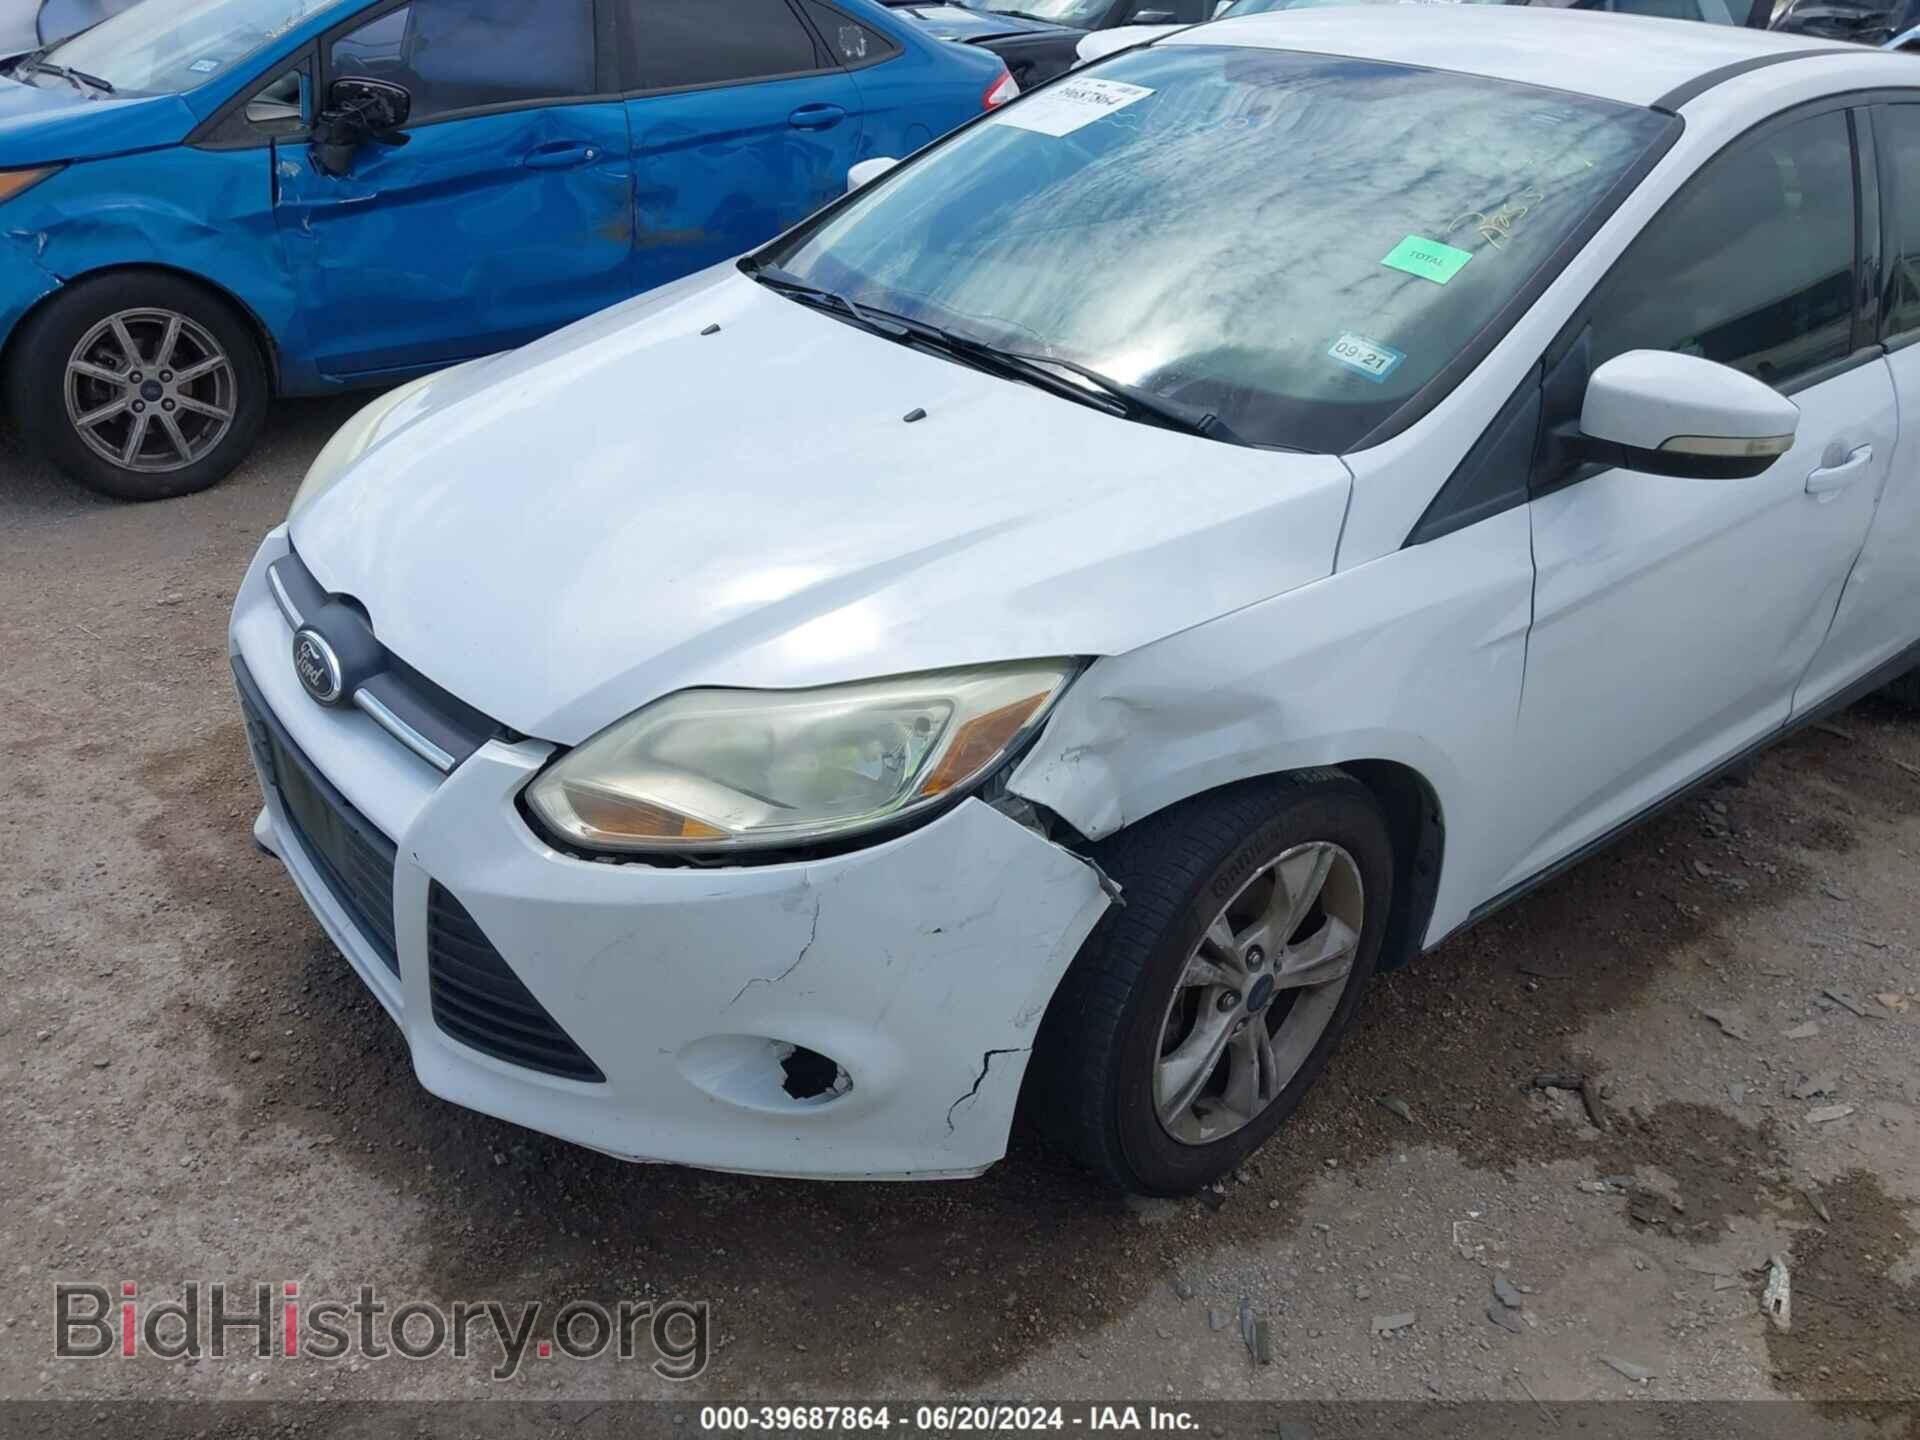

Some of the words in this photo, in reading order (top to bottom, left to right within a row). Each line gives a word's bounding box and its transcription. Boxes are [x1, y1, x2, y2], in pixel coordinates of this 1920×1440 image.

[1408, 251, 1444, 267] TOTAL
[1335, 341, 1355, 358] 09
[1362, 352, 1386, 370] 21
[299, 641, 324, 686] Ford
